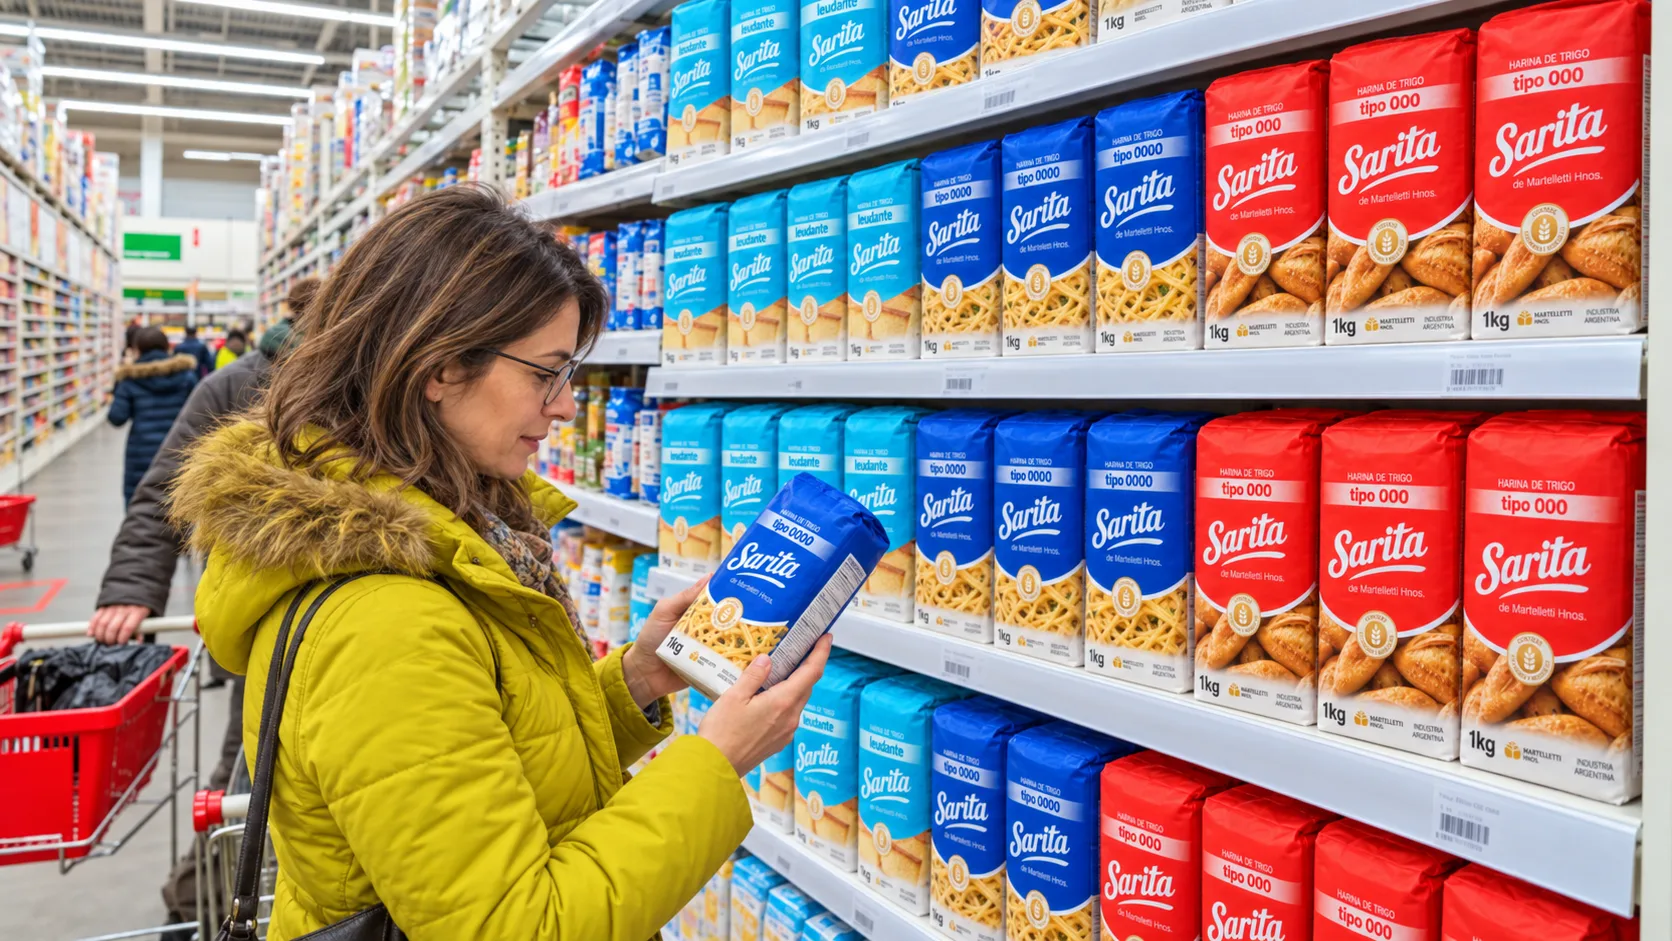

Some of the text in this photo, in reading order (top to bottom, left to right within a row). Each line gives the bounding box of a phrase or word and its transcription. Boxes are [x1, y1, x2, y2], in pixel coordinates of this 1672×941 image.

[741, 18, 774, 35] leudante
[1105, 16, 1124, 30] 1kg
[809, 20, 864, 66] Sarita
[734, 40, 780, 80] Sarita
[1508, 48, 1590, 70] HARINA DE TRIGO
[672, 58, 711, 98] Sarita
[1357, 76, 1424, 96] HARINA DE TRIGO
[1512, 66, 1584, 93] tipo 000
[1228, 102, 1284, 120] HARINA DE TRIGO
[1360, 92, 1420, 118] tipo 000
[806, 119, 820, 130] 1kg
[1134, 134, 1142, 142] DE
[1143, 129, 1163, 139] TRIGO
[1231, 118, 1281, 141] tipo 000
[1488, 102, 1608, 178] Sarita
[1113, 142, 1163, 164] tipo 0000
[1338, 126, 1441, 196] Sarita
[1018, 167, 1060, 186] tipo 0000
[1213, 148, 1298, 212] Sarita
[1512, 170, 1603, 189] de Martelletti Hnos.
[934, 186, 972, 203] tipo 0000
[1100, 170, 1176, 228] Sarita
[1358, 189, 1438, 206] de Martelletti Hnos.
[857, 210, 892, 226] leudante
[1006, 191, 1072, 244] Sarita
[1230, 212, 1238, 221] de
[1240, 208, 1272, 219] Martelletti
[736, 233, 766, 248] leudante
[795, 224, 829, 238] leudante
[926, 208, 981, 257] Sarita
[790, 244, 834, 283] Sarita
[850, 232, 901, 276] Sarita
[666, 264, 707, 300] Sarita
[730, 252, 772, 291] Sarita
[1332, 318, 1356, 336] 1kg
[1482, 311, 1510, 331] 1kg
[1006, 334, 1020, 350] 1kg
[1100, 330, 1115, 346] 1kg
[1209, 324, 1229, 342] 1kg
[924, 340, 938, 354] 1kg
[730, 454, 757, 464] leudante
[788, 456, 820, 468] leudante
[854, 460, 888, 472] leudante
[930, 464, 966, 476] tipo 0000
[1010, 470, 1052, 483] tipo 0000
[1105, 473, 1153, 488] tipo 0000
[1220, 468, 1274, 478] HARINA DE TRIGO
[1347, 472, 1412, 484] HARINA DE TRIGO
[664, 471, 702, 503] Sarita
[724, 474, 762, 508] Sarita
[1222, 482, 1272, 498] tipo 000
[1350, 487, 1409, 504] tipo 000
[1498, 478, 1576, 492] HARINA DE TRIGO
[920, 486, 974, 528] Sarita
[1501, 496, 1568, 516] tipo 000
[999, 496, 1062, 541] Sarita
[1092, 502, 1165, 550] Sarita
[772, 518, 814, 546] tipo 0000
[1203, 512, 1288, 566] Sarita
[727, 542, 801, 579] Sarita
[1328, 522, 1428, 579] Sarita
[1220, 569, 1285, 582] de Martelletti Hnos.
[1475, 536, 1592, 596] Sarita
[1348, 584, 1425, 598] de Martelletti Hnos.
[918, 608, 929, 624] 1kg
[1498, 603, 1588, 622] de Martelletti Hnos.
[666, 636, 684, 656] 1kg
[998, 628, 1011, 646] 1kg
[1089, 649, 1104, 668] 1kg
[1199, 674, 1220, 698] 1kg
[802, 714, 834, 733] leudante
[1323, 701, 1346, 726] 1kg
[870, 736, 904, 758] leudante
[1468, 730, 1496, 758] 1kg
[796, 742, 840, 774] Sarita
[944, 760, 980, 782] tipo 0000
[862, 767, 912, 800] Sarita
[934, 790, 988, 826] Sarita
[1020, 789, 1060, 813] tipo 0000
[1136, 817, 1144, 828] DE
[1146, 820, 1164, 834] TRIGO
[1010, 820, 1070, 858] Sarita
[1118, 824, 1162, 852] tipo 000
[1222, 849, 1274, 874] HARINA DE TRIGO
[1104, 860, 1176, 900] Sarita
[1222, 864, 1272, 894] tipo 000
[1336, 888, 1396, 920] HARINA DE TRIGO
[1207, 901, 1286, 941] Sarita
[1338, 906, 1393, 940] tipo 000
